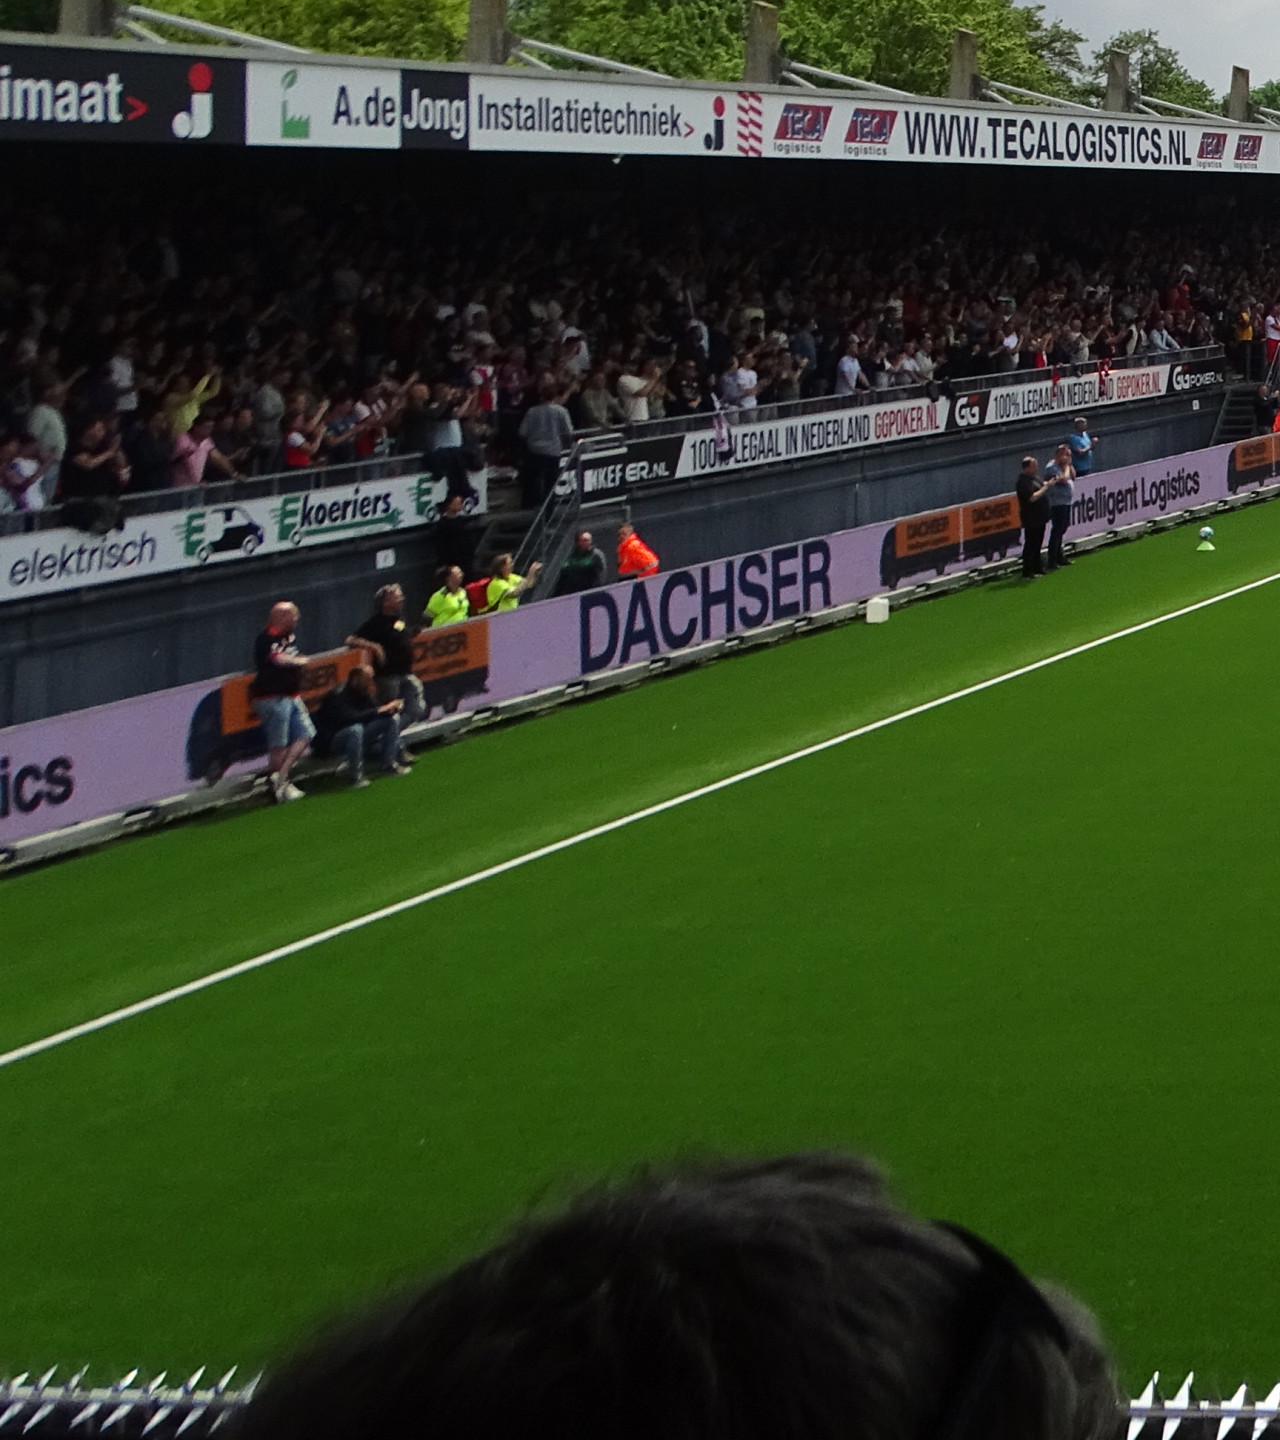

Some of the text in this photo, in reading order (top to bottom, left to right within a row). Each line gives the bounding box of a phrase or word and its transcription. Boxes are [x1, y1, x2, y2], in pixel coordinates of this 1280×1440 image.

[403, 89, 468, 140] Jong
[478, 93, 682, 137] Installatietechniek
[783, 109, 823, 141] TECA
[851, 114, 890, 141] TECA
[904, 110, 1192, 165] WWW.TECALOGISTICS.NL
[773, 141, 821, 154] logistics
[843, 143, 887, 157] logistics
[994, 389, 1020, 418] 100%
[1117, 371, 1161, 400] GGPOKER.NL
[690, 402, 939, 471] 100 LEGAAL IN NEDERLAND GGPOKER.NL
[1070, 471, 1200, 525] ntelligent Logistics
[8, 532, 157, 588] elektrisch
[579, 539, 832, 675] DACHSER
